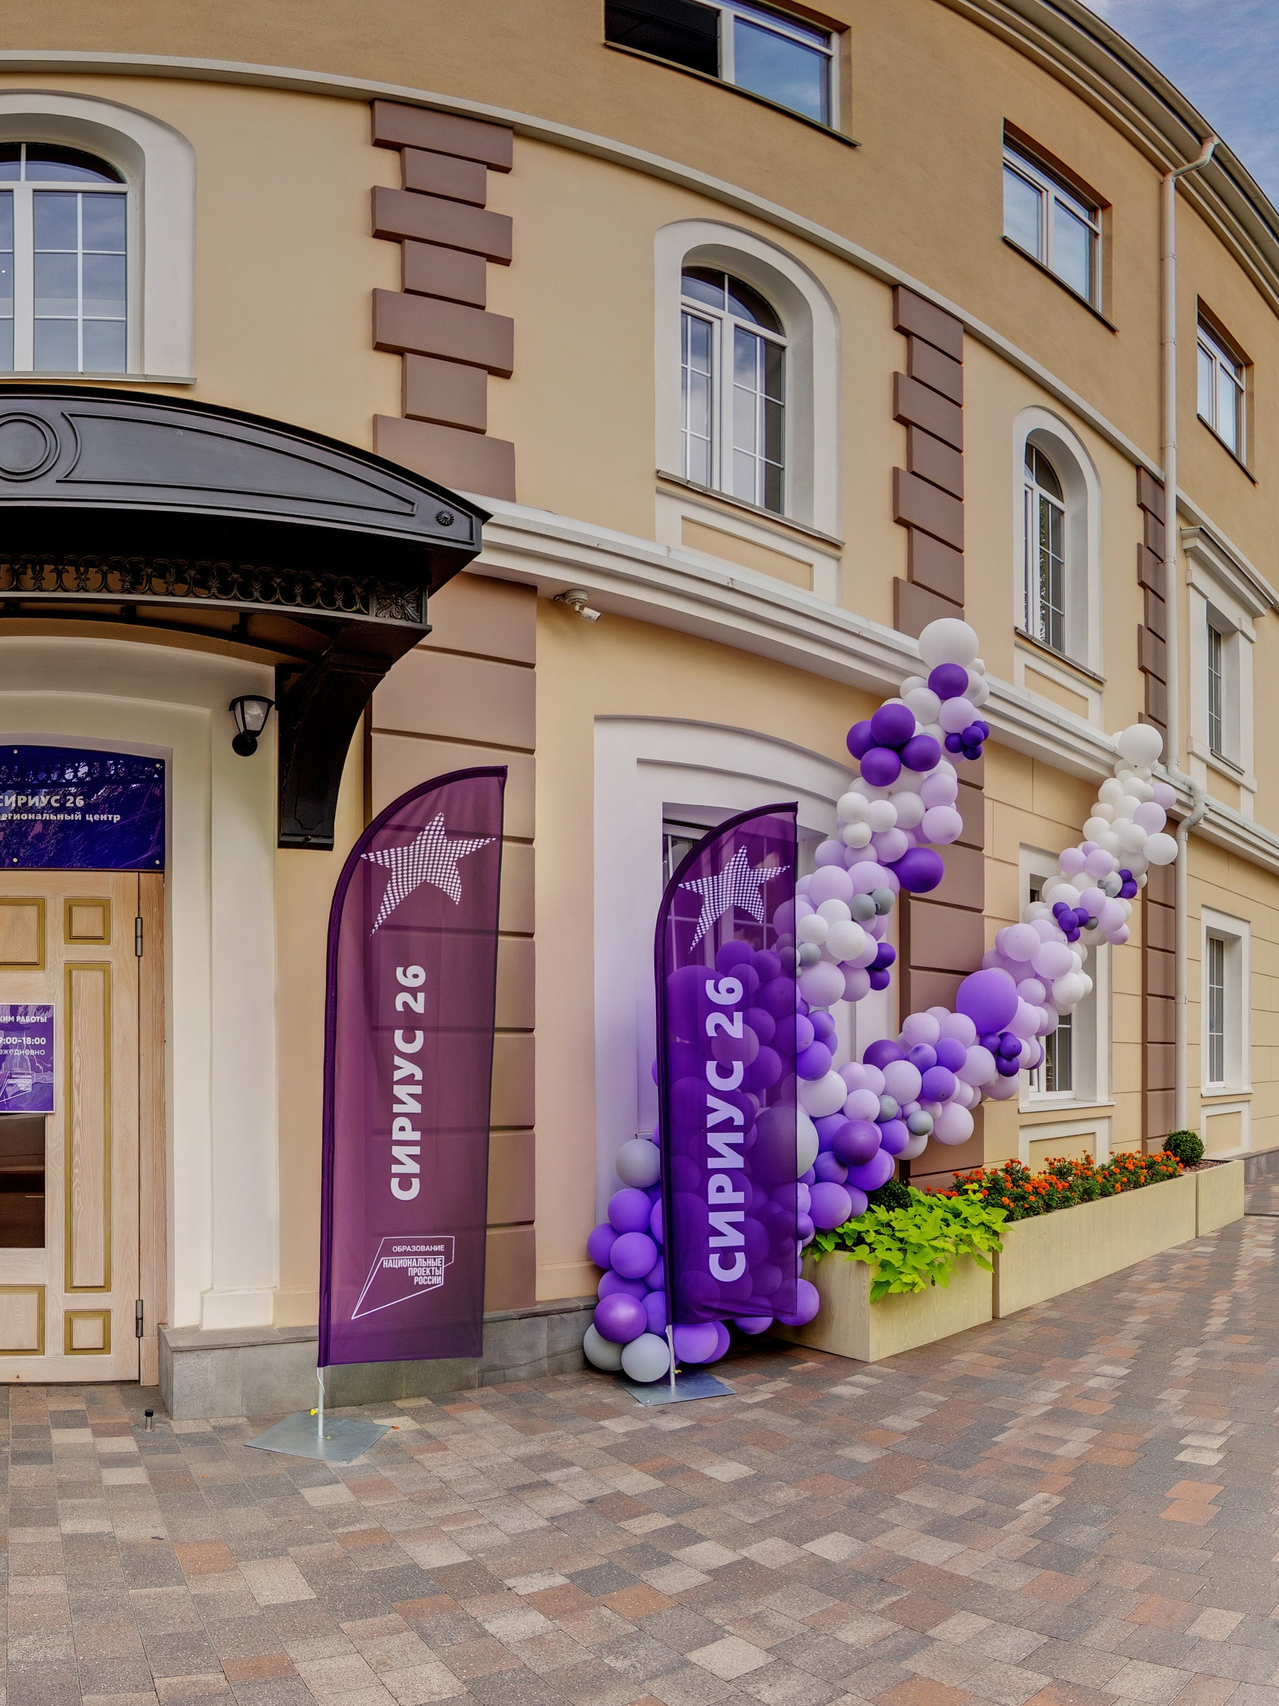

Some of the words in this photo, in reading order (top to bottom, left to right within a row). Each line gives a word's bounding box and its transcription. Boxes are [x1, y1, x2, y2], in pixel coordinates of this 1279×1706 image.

[66, 795, 85, 807] 26
[86, 813, 121, 823] центр
[395, 965, 426, 1014] 26
[705, 976, 744, 1039] 26
[390, 1029, 424, 1201] СИРИУС
[705, 1060, 747, 1283] СИРИУС
[383, 1257, 442, 1269] НАЦИОНАЛЬНЫЕ
[408, 1266, 442, 1276] ПРОЕКТЫ
[413, 1276, 442, 1285] РОССИИ
